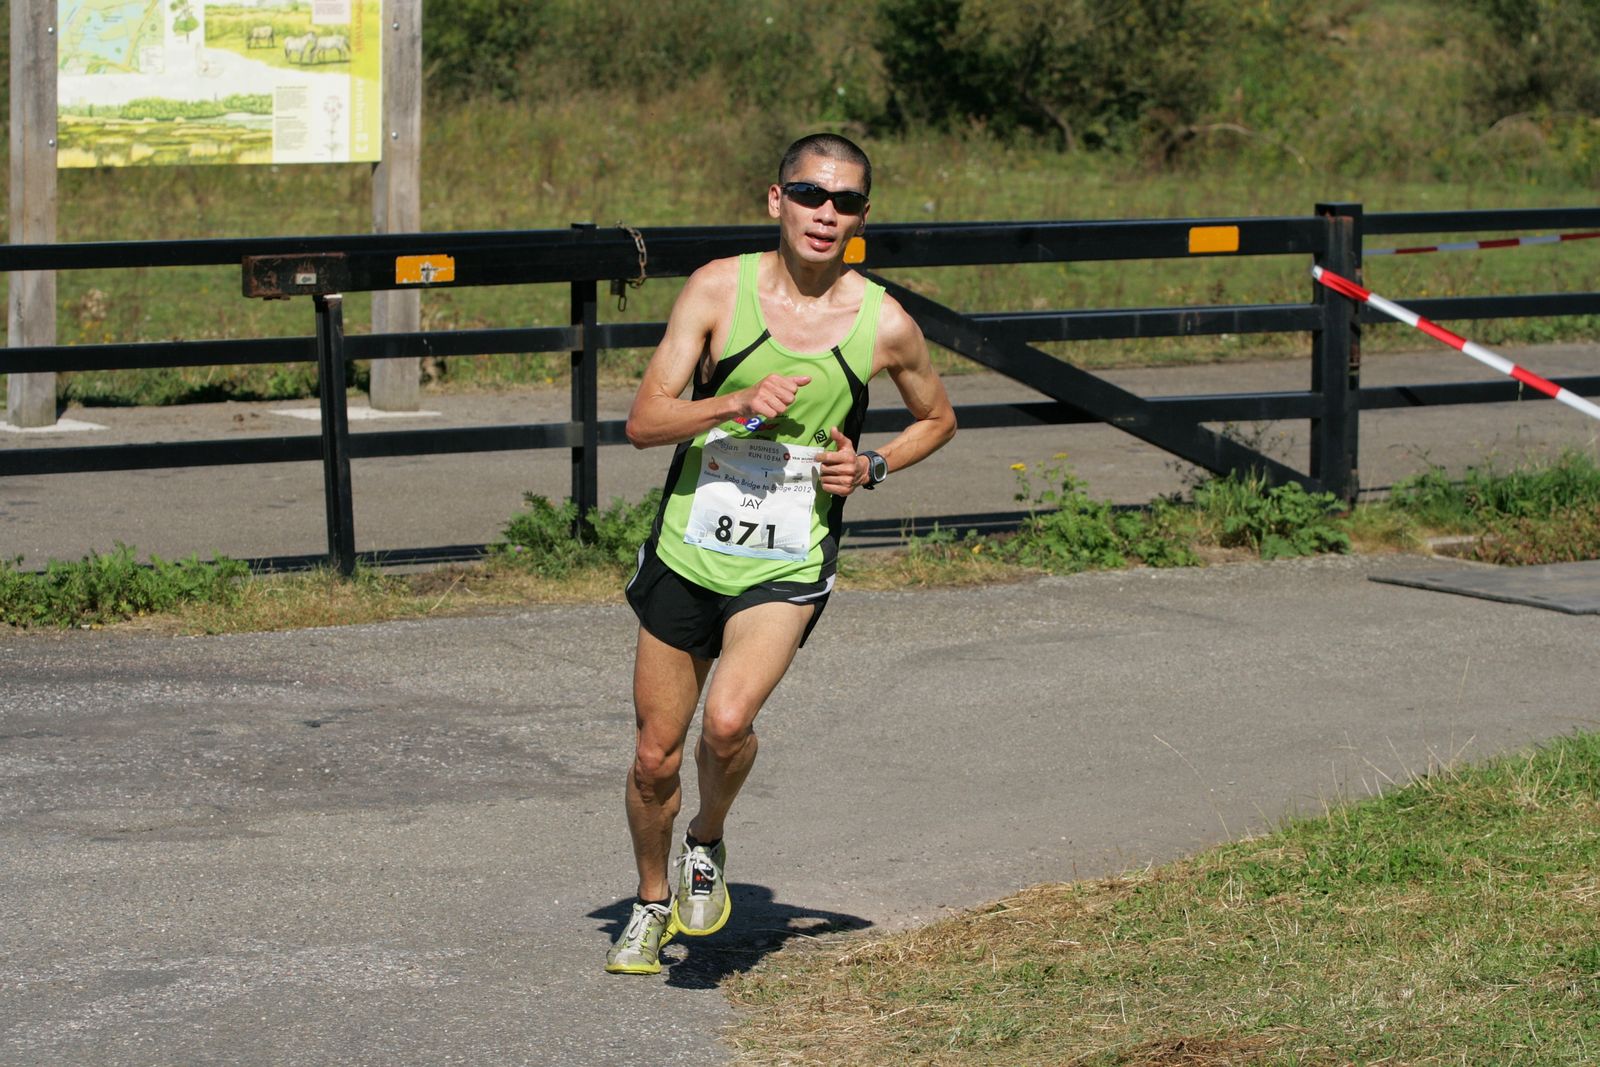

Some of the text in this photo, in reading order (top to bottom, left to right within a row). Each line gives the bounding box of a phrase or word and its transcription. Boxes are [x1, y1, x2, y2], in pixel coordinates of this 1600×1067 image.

[746, 417, 760, 430] 2
[749, 445, 780, 454] BUSINESS
[724, 474, 740, 484] Rabo
[741, 480, 760, 490] Bridge
[793, 485, 812, 493] 2012
[740, 497, 763, 510] JAY
[715, 515, 776, 549] 871
